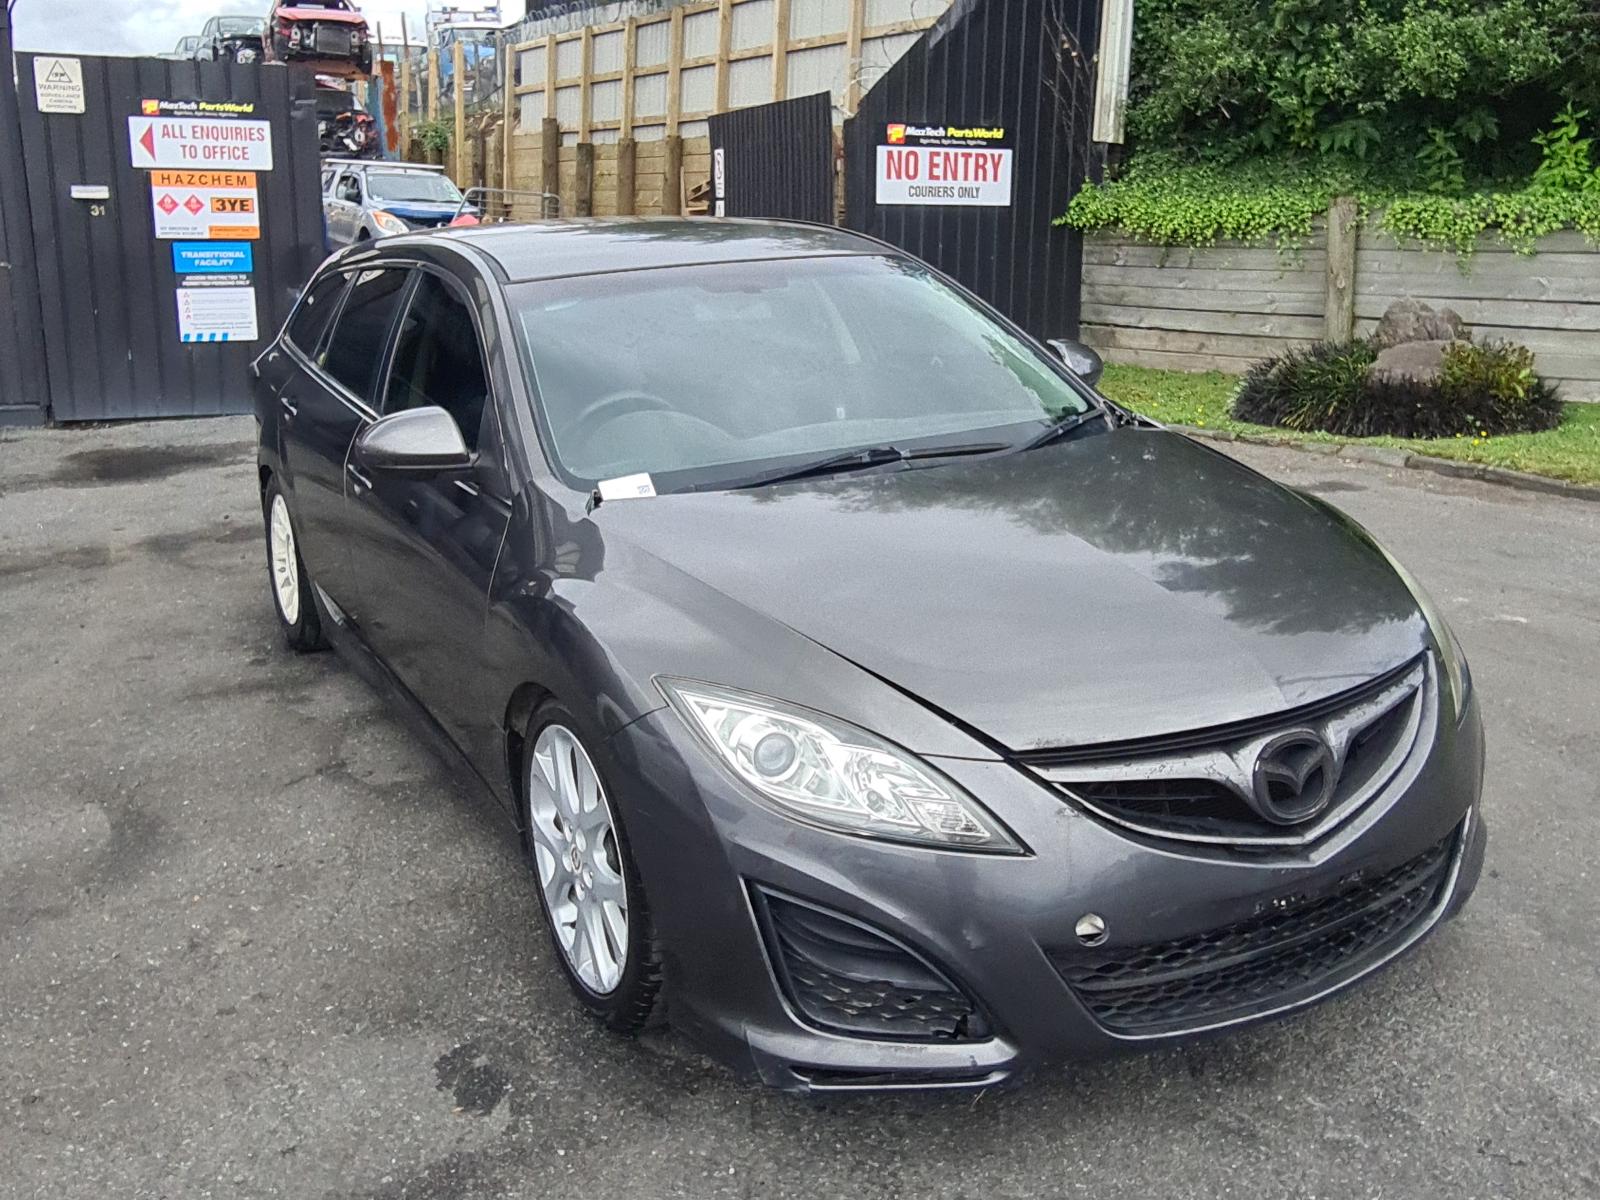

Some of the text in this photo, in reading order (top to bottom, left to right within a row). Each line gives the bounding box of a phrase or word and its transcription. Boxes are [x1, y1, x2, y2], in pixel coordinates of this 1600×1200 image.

[160, 101, 254, 113] MaxTech PartsWorld
[161, 124, 265, 142] ALL ENQUIRIES
[905, 126, 1004, 139] MaxTech PartsWorld
[180, 145, 249, 160] TO OFFICE
[886, 150, 1002, 182] NO ENTRY
[161, 174, 247, 186] HAZCHEM
[908, 186, 980, 199] COURIERS ONLY
[90, 205, 105, 216] 31
[215, 199, 250, 212] 3YE
[181, 251, 246, 259] TRANSITIONAL
